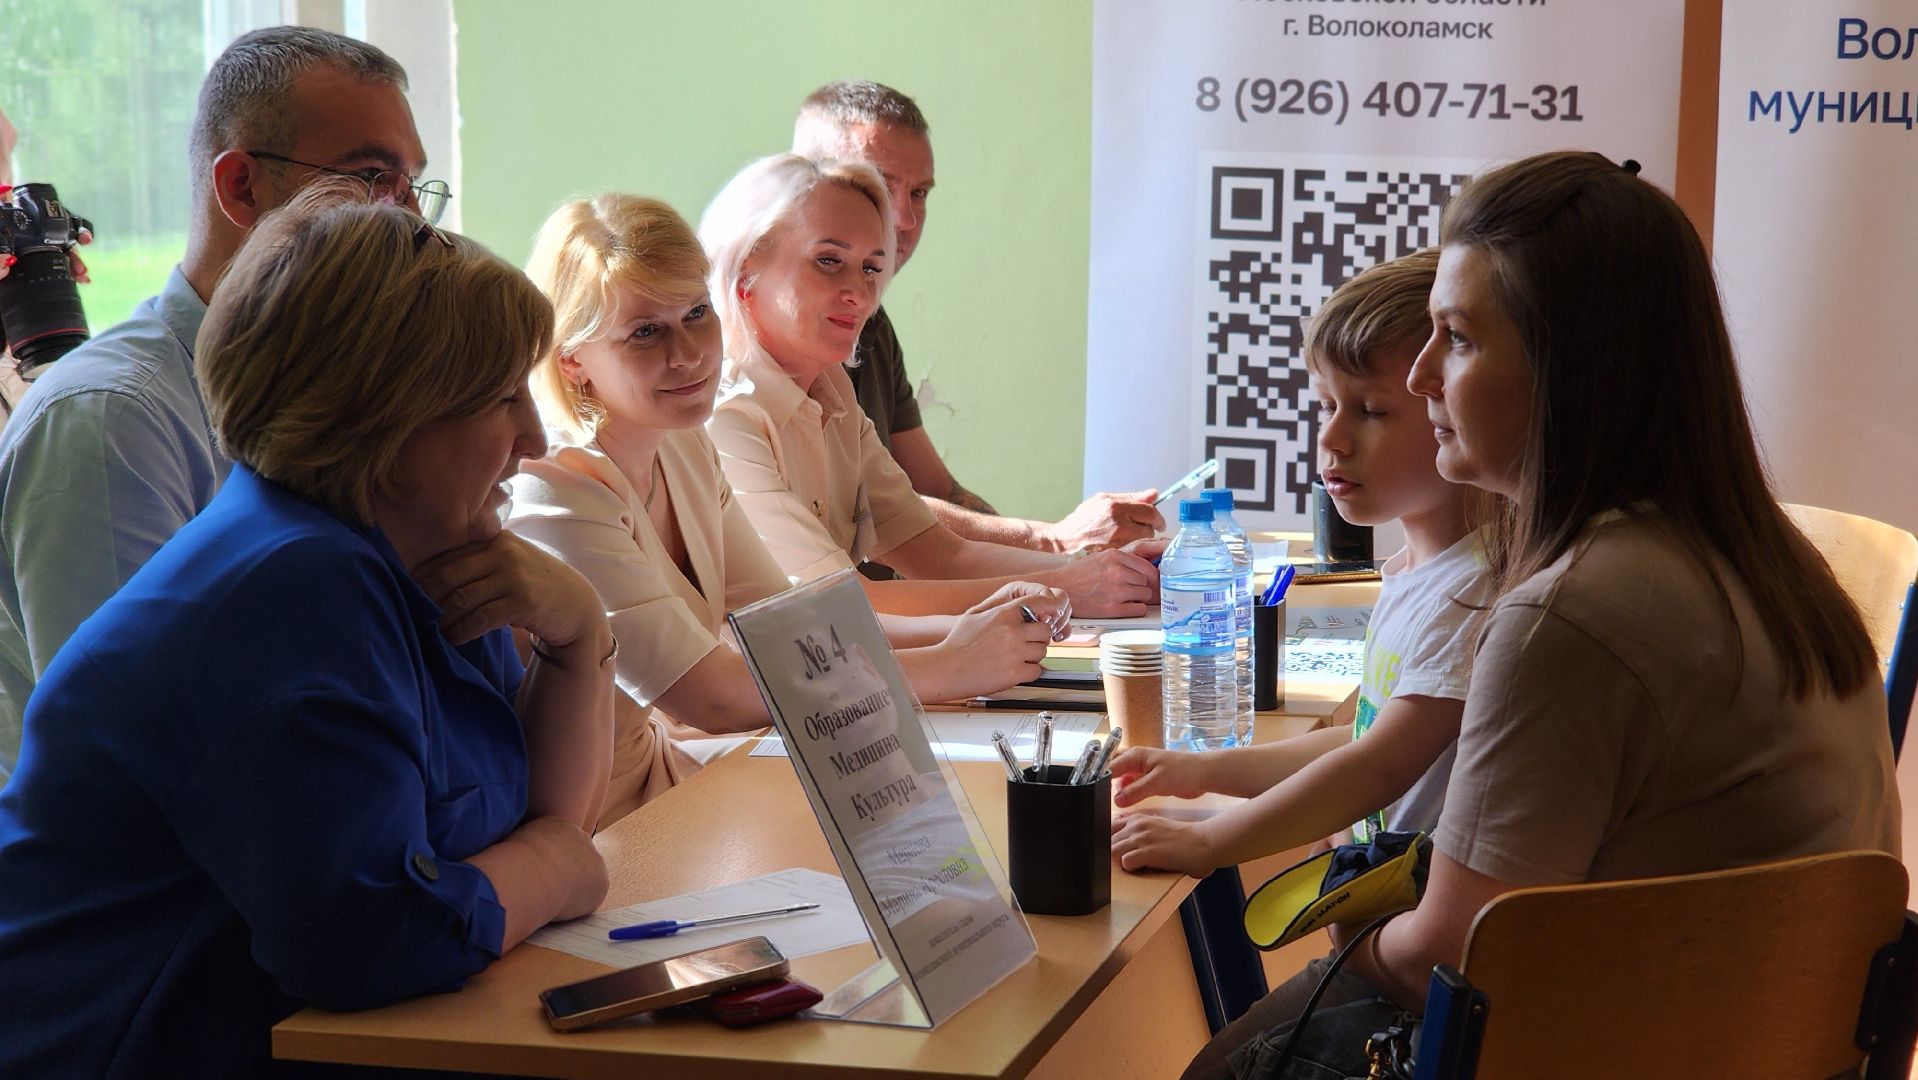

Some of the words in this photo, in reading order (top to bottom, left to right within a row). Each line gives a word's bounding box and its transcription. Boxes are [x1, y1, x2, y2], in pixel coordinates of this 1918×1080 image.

[1283, 18, 1299, 36] г.
[1308, 14, 1494, 39] Волоколамск
[1196, 76, 1221, 113] 8
[1233, 77, 1350, 126] (926)
[1362, 81, 1583, 123] 407-71-31
[1748, 90, 1918, 135] муниц
[794, 634, 831, 681] №
[830, 624, 849, 664] 4
[804, 688, 890, 741] Образование
[829, 733, 901, 780] Медицина
[850, 773, 917, 822] Культура
[880, 886, 922, 917] Марина
